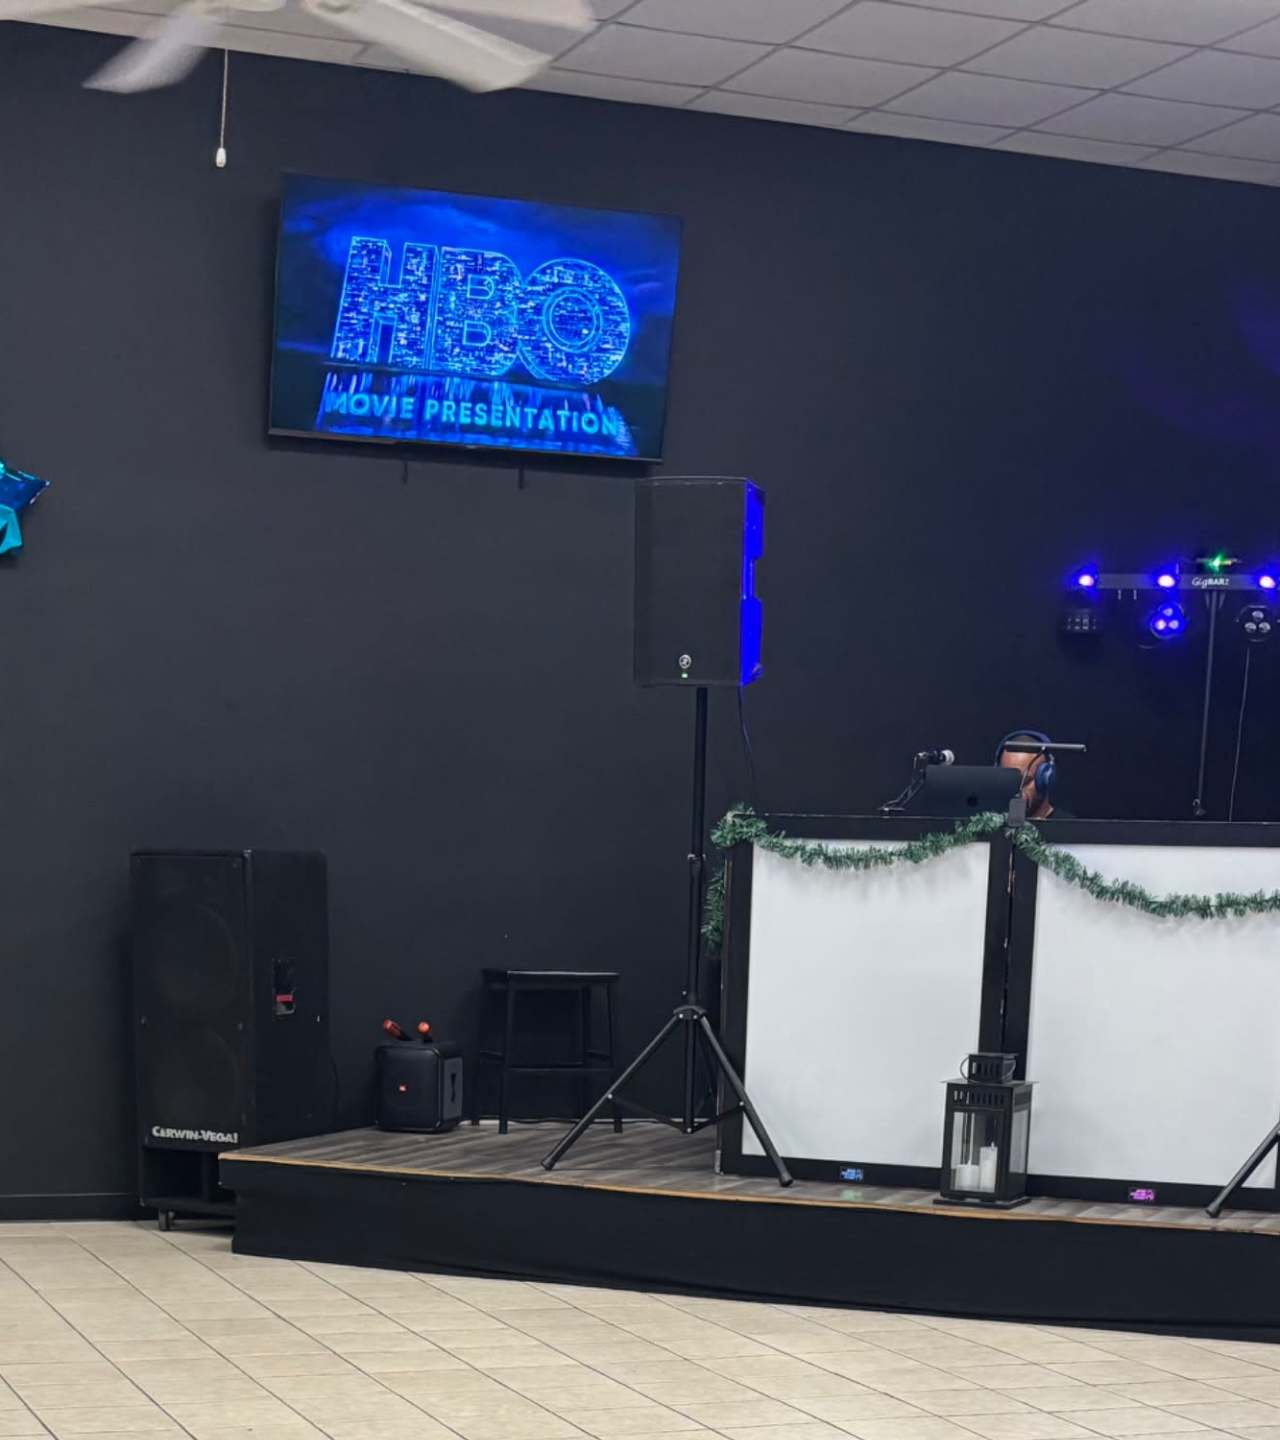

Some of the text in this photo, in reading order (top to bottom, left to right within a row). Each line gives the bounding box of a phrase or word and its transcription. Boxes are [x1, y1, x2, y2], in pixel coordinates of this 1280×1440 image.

[330, 236, 631, 385] HBO
[325, 392, 617, 435] MOVIE PRESENTATION
